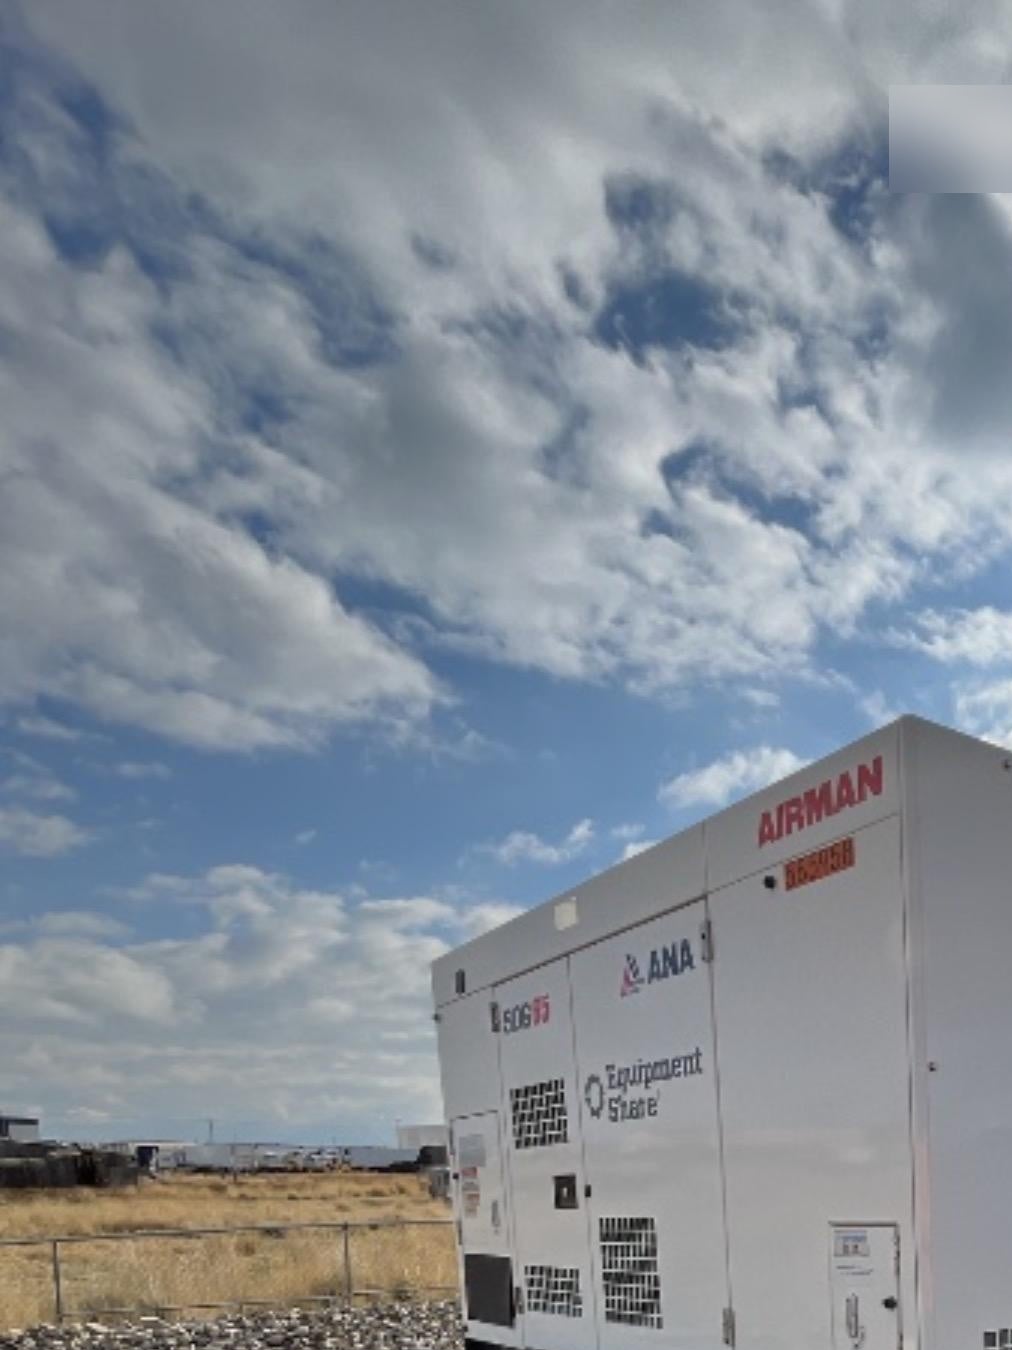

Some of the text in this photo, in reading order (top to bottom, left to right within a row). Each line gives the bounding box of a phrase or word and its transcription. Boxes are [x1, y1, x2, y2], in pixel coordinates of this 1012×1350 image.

[758, 755, 883, 848] AIRMAN
[647, 938, 695, 984] ANA
[605, 1047, 703, 1092] Equipment
